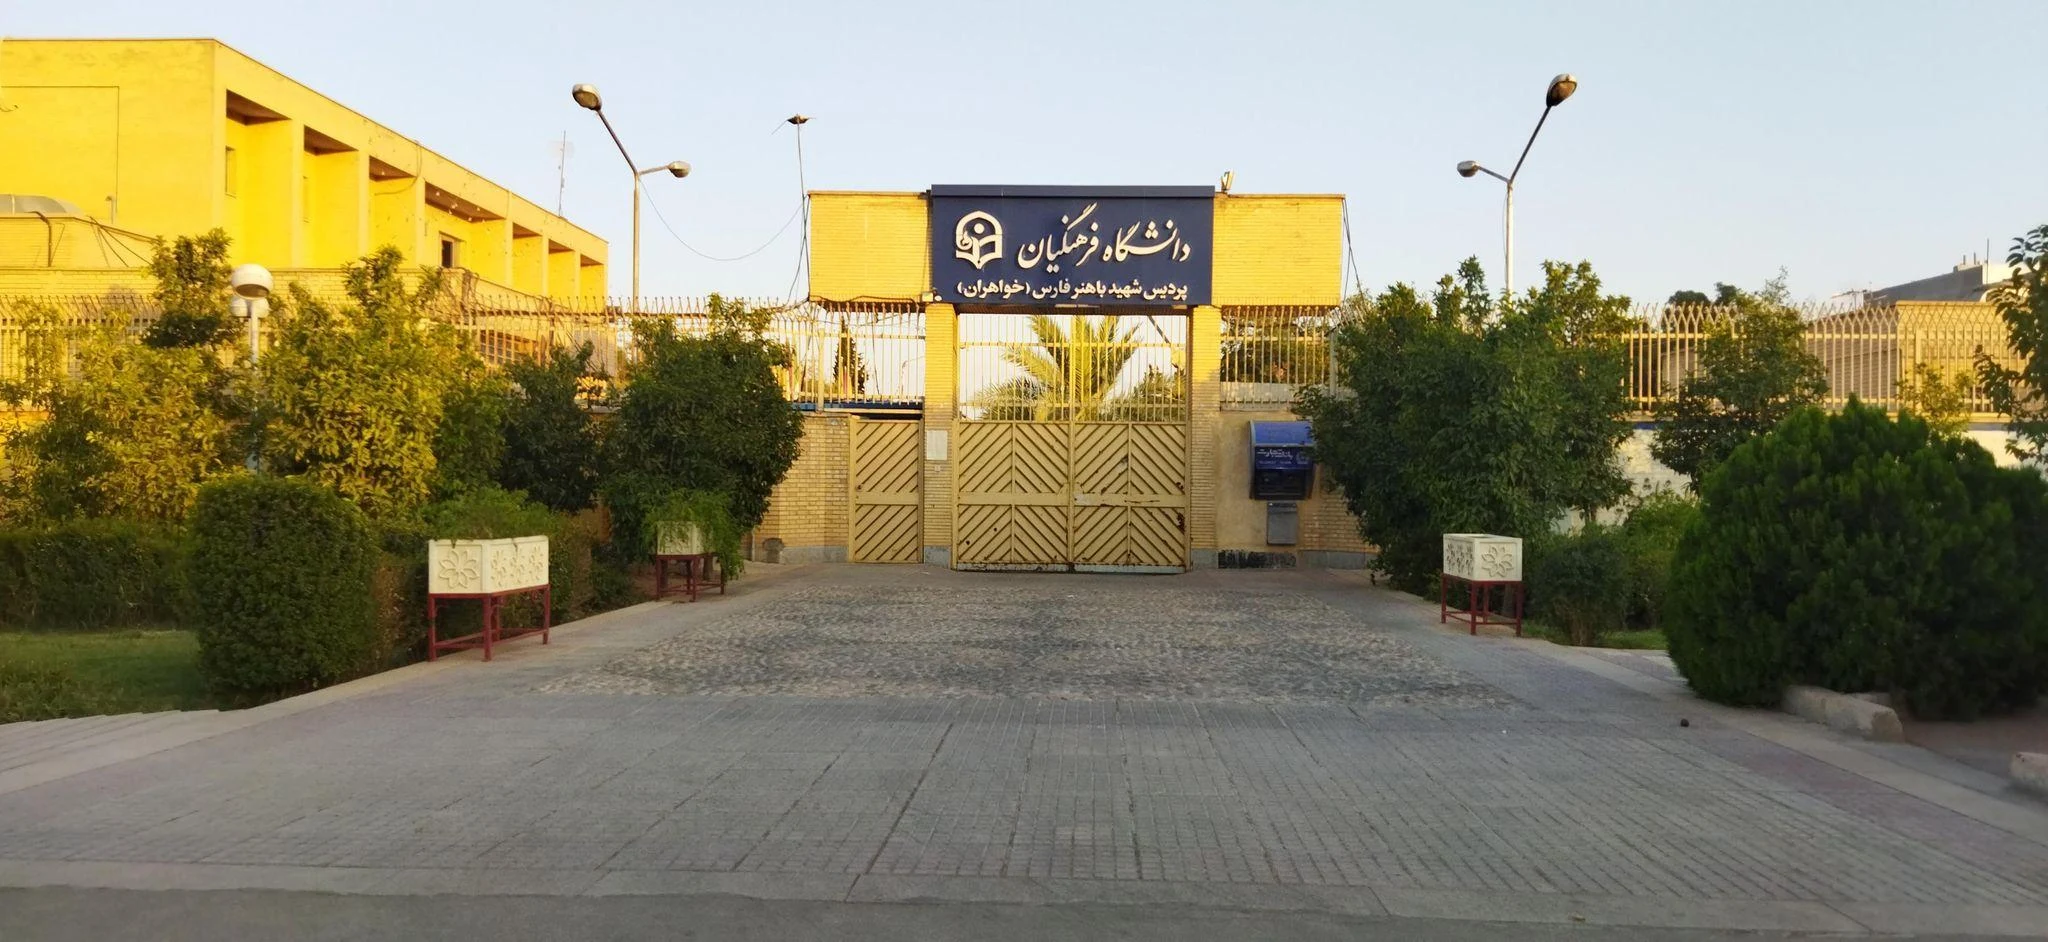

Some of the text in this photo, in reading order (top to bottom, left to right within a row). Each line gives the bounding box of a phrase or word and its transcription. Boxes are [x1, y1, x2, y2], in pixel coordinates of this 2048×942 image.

[1017, 202, 1192, 273] دانشگاه فرهنگیان
[956, 278, 1188, 302] پردیس شهید باهنر فارس (خواهران)
